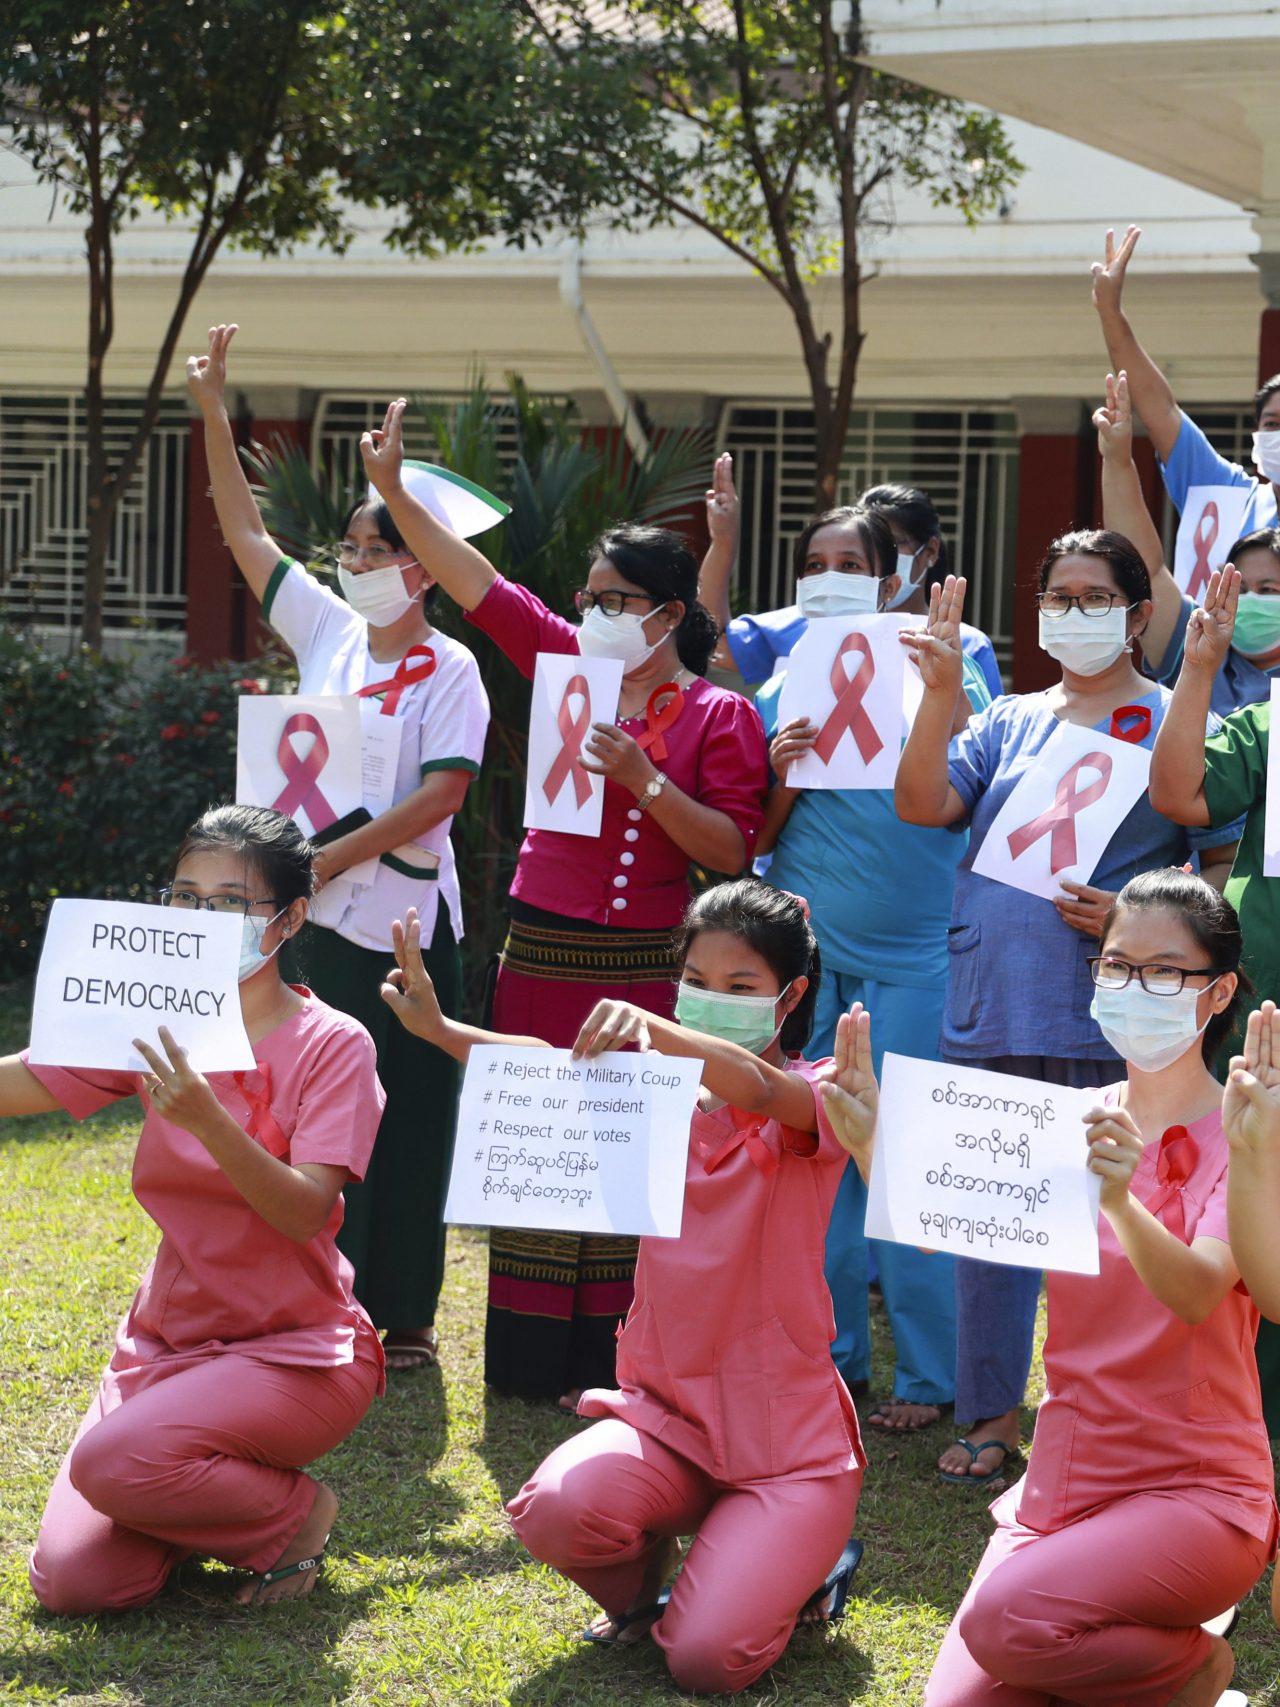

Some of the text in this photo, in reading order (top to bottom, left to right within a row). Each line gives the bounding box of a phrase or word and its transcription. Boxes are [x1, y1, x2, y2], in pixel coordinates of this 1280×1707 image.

[92, 924, 206, 960] PROTECT
[63, 976, 225, 1017] DEMOCRACY
[488, 1062, 681, 1088] # Reject the Military Coup
[483, 1091, 644, 1114] # Free our president
[931, 1080, 1055, 1129] စစ်အာဏာရှင်
[479, 1120, 631, 1143] # Respect our votes
[955, 1129, 1031, 1169] အလိုမရှိ
[474, 1149, 483, 1162] #
[926, 1162, 1051, 1212] စစ်အာဏာရှင်
